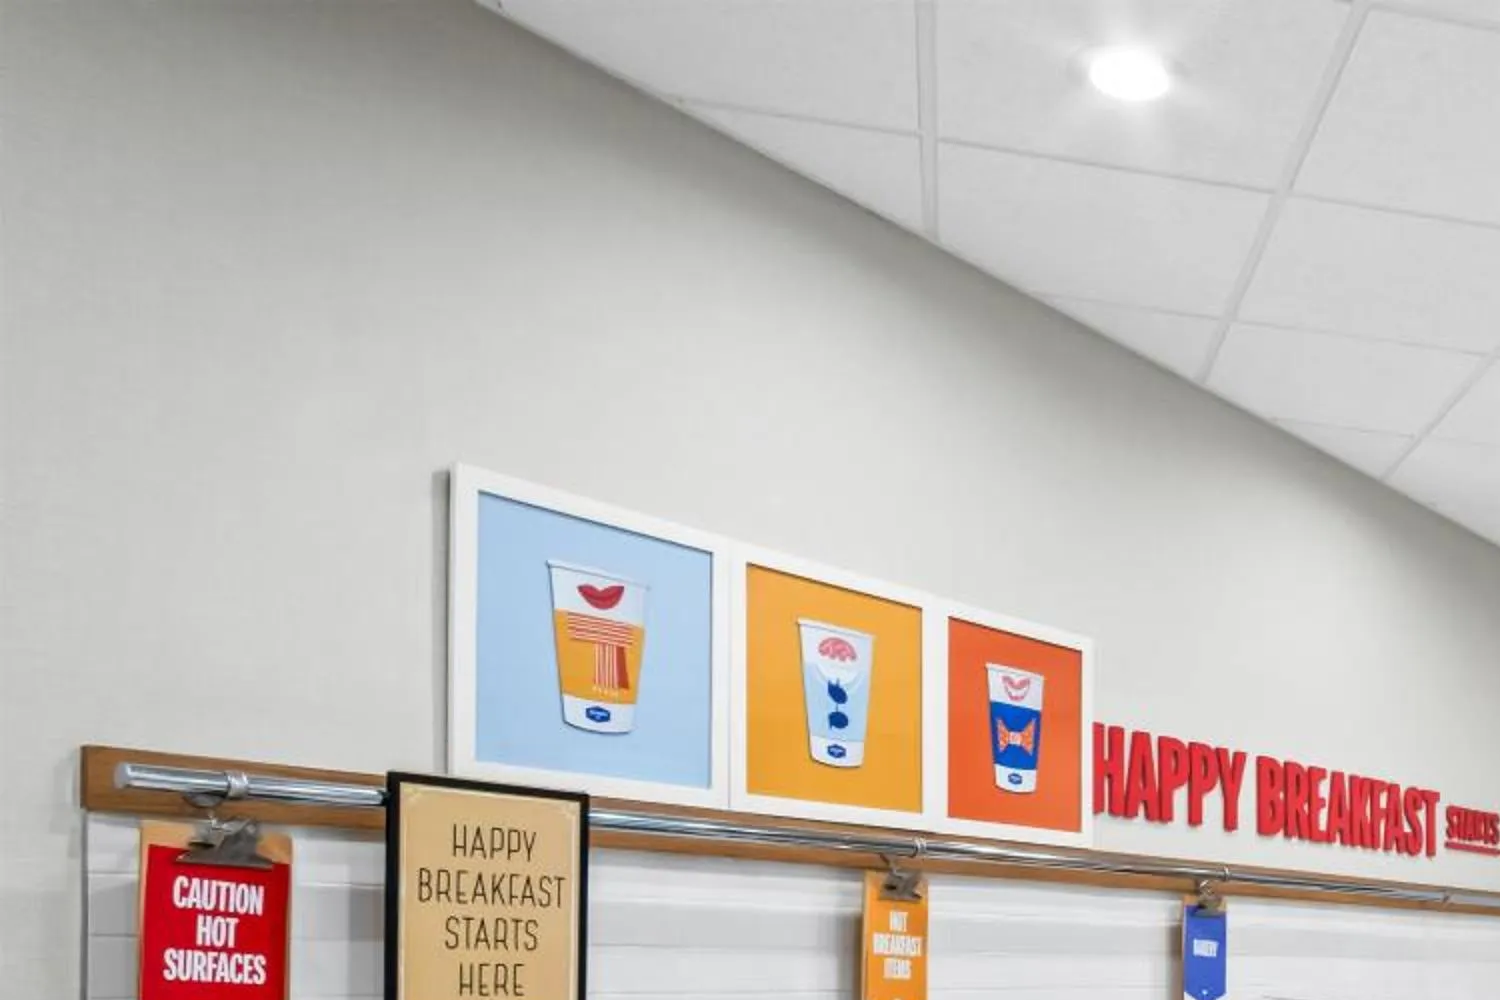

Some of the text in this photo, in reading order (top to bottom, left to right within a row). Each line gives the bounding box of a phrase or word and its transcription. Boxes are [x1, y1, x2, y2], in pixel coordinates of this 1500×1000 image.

[1092, 721, 1247, 832] HAPPY
[1256, 755, 1440, 857] BREAKFAST
[452, 823, 537, 862] HAPPY
[173, 875, 265, 916] CAUTION
[418, 867, 566, 908] BREAKFAST
[196, 914, 240, 948] HOT
[445, 915, 539, 951] STARTS
[163, 947, 267, 985] SURFACES
[459, 962, 525, 997] HERE
